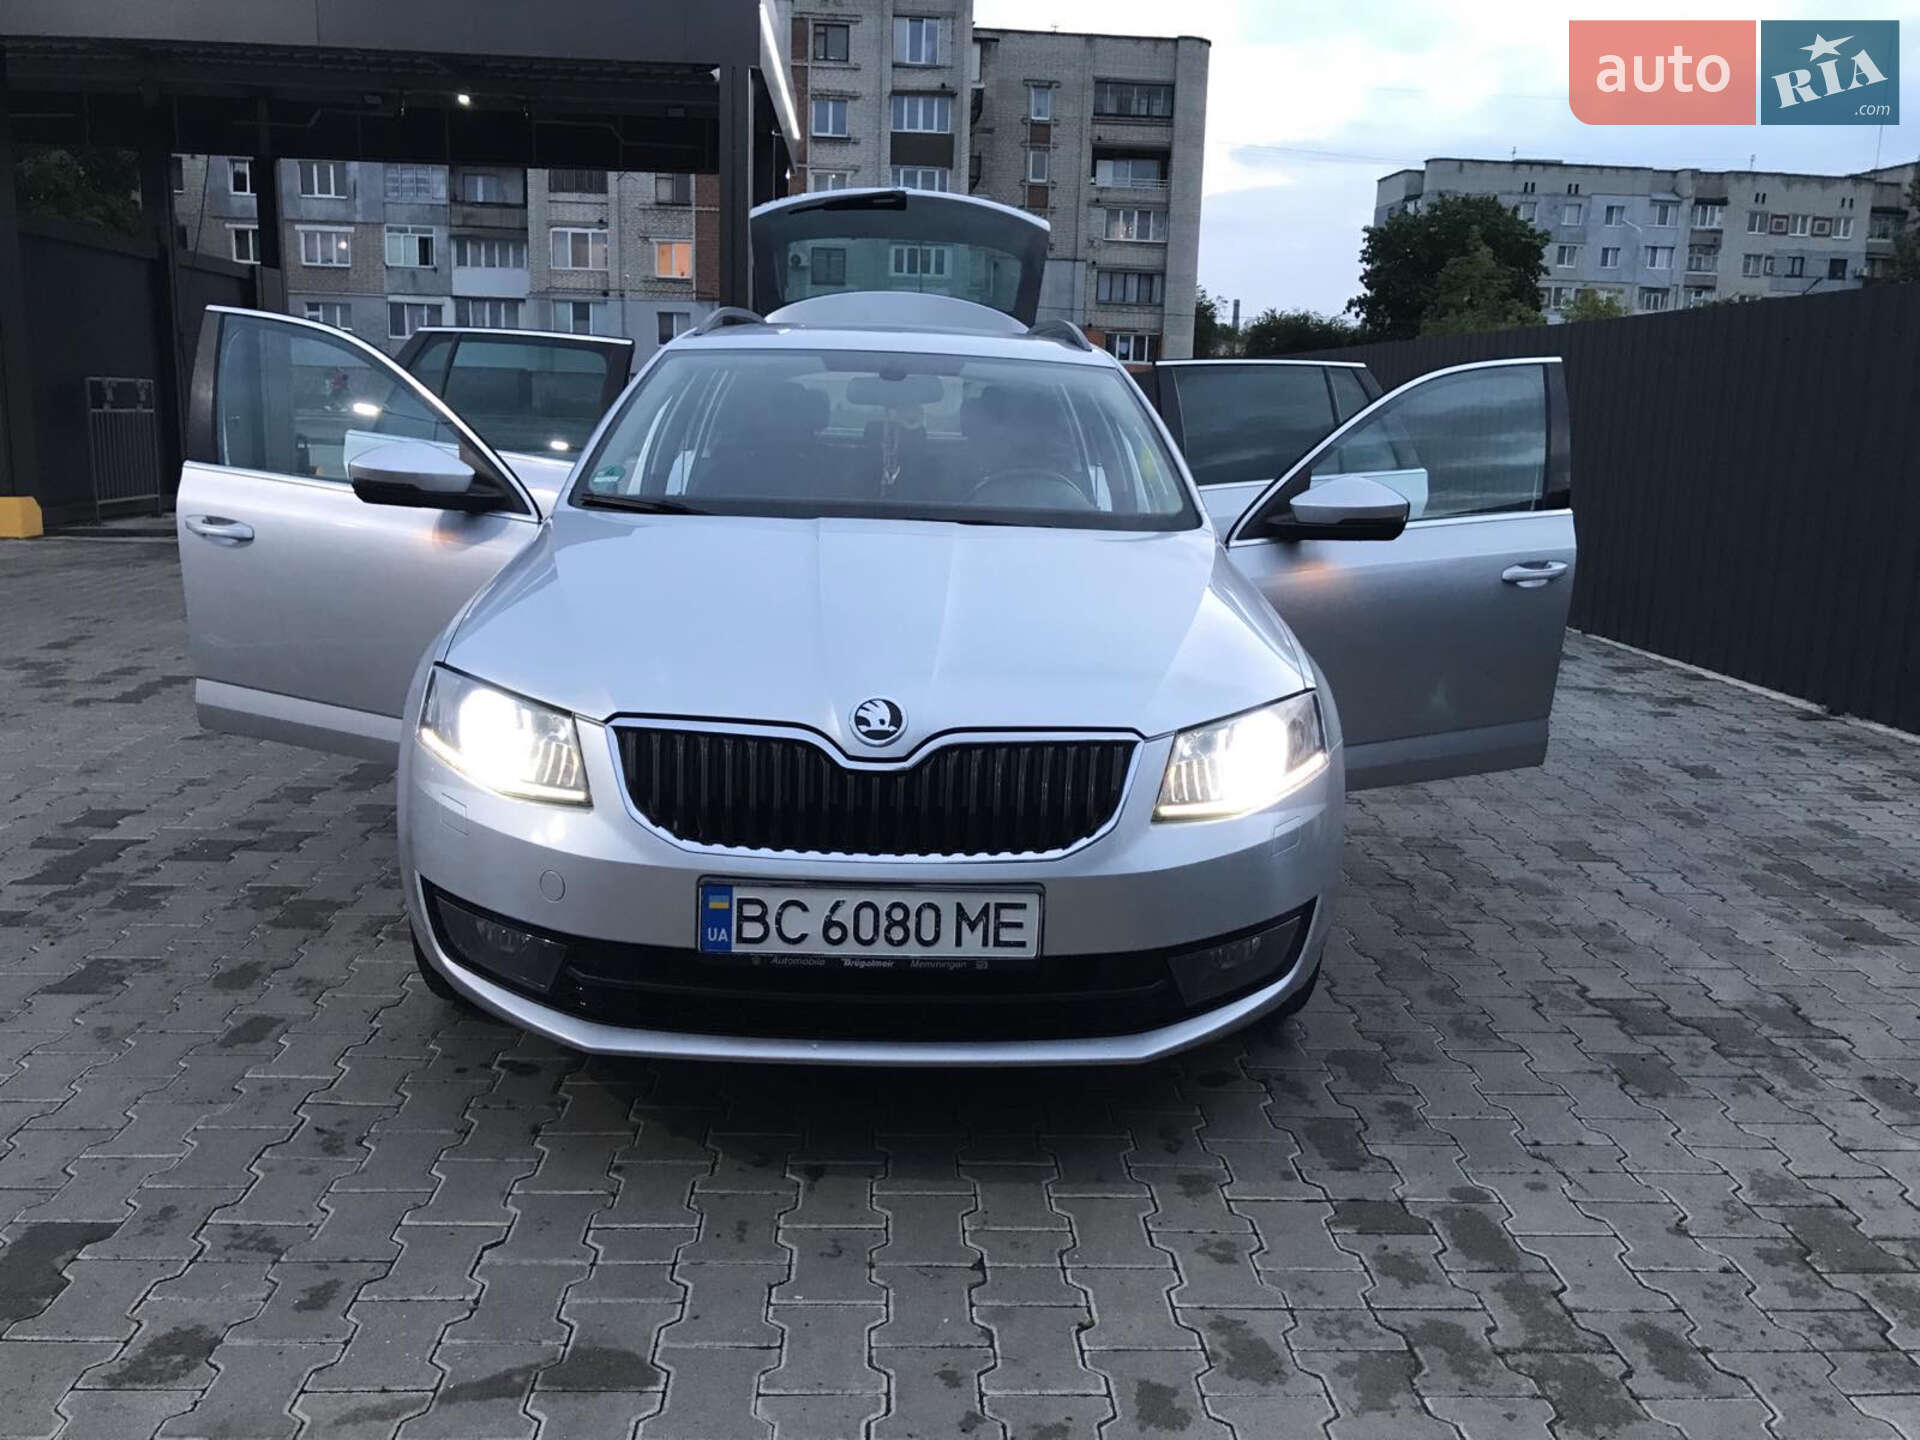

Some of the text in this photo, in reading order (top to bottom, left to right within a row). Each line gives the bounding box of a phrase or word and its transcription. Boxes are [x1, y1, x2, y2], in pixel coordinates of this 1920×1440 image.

[707, 927, 728, 942] UA
[735, 897, 1027, 948] BC 6080 ME
